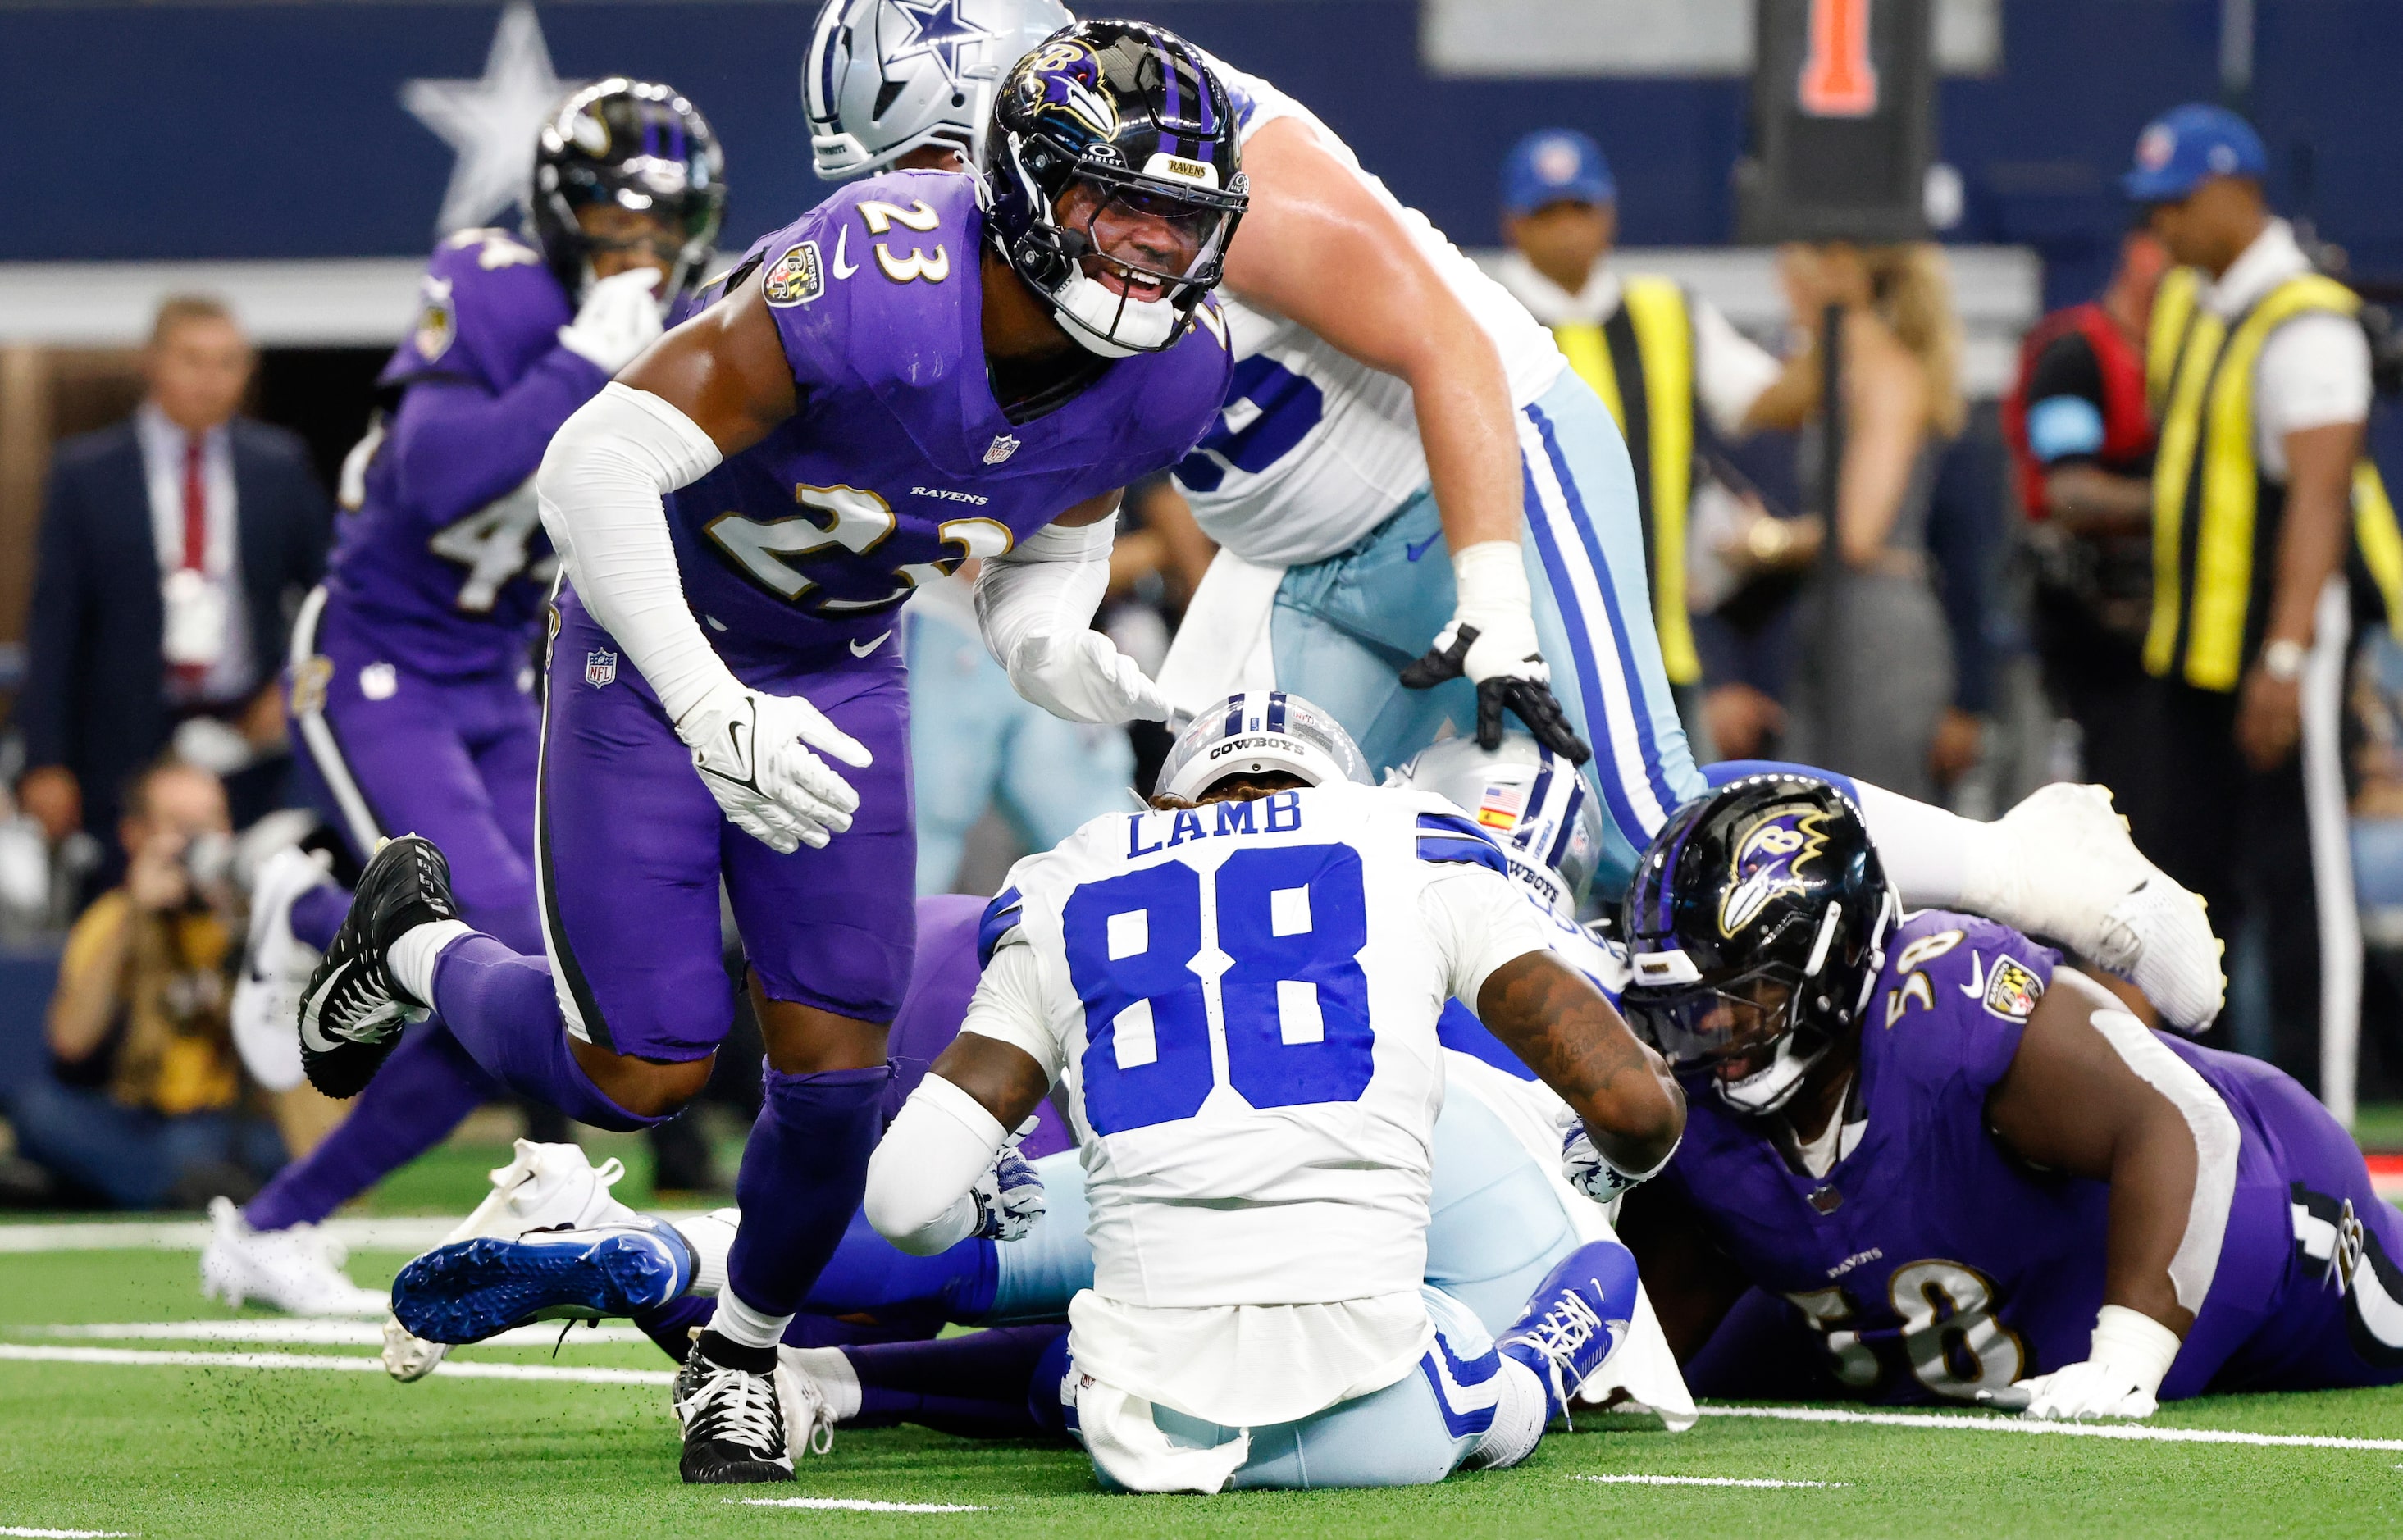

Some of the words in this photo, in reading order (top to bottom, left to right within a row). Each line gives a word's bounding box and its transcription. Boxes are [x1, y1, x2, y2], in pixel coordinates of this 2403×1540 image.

[1081, 153, 1122, 166] OAKLEY
[1168, 160, 1207, 178] RAVENS
[856, 199, 951, 285] 23
[804, 247, 818, 290] RAVENS
[910, 486, 990, 507] RAVENS
[1209, 737, 1306, 760] COWBOYS
[1126, 791, 1302, 860] LAMB
[1506, 859, 1560, 904] WBOYS
[1061, 842, 1375, 1138] 88
[1885, 929, 1964, 1031] 58
